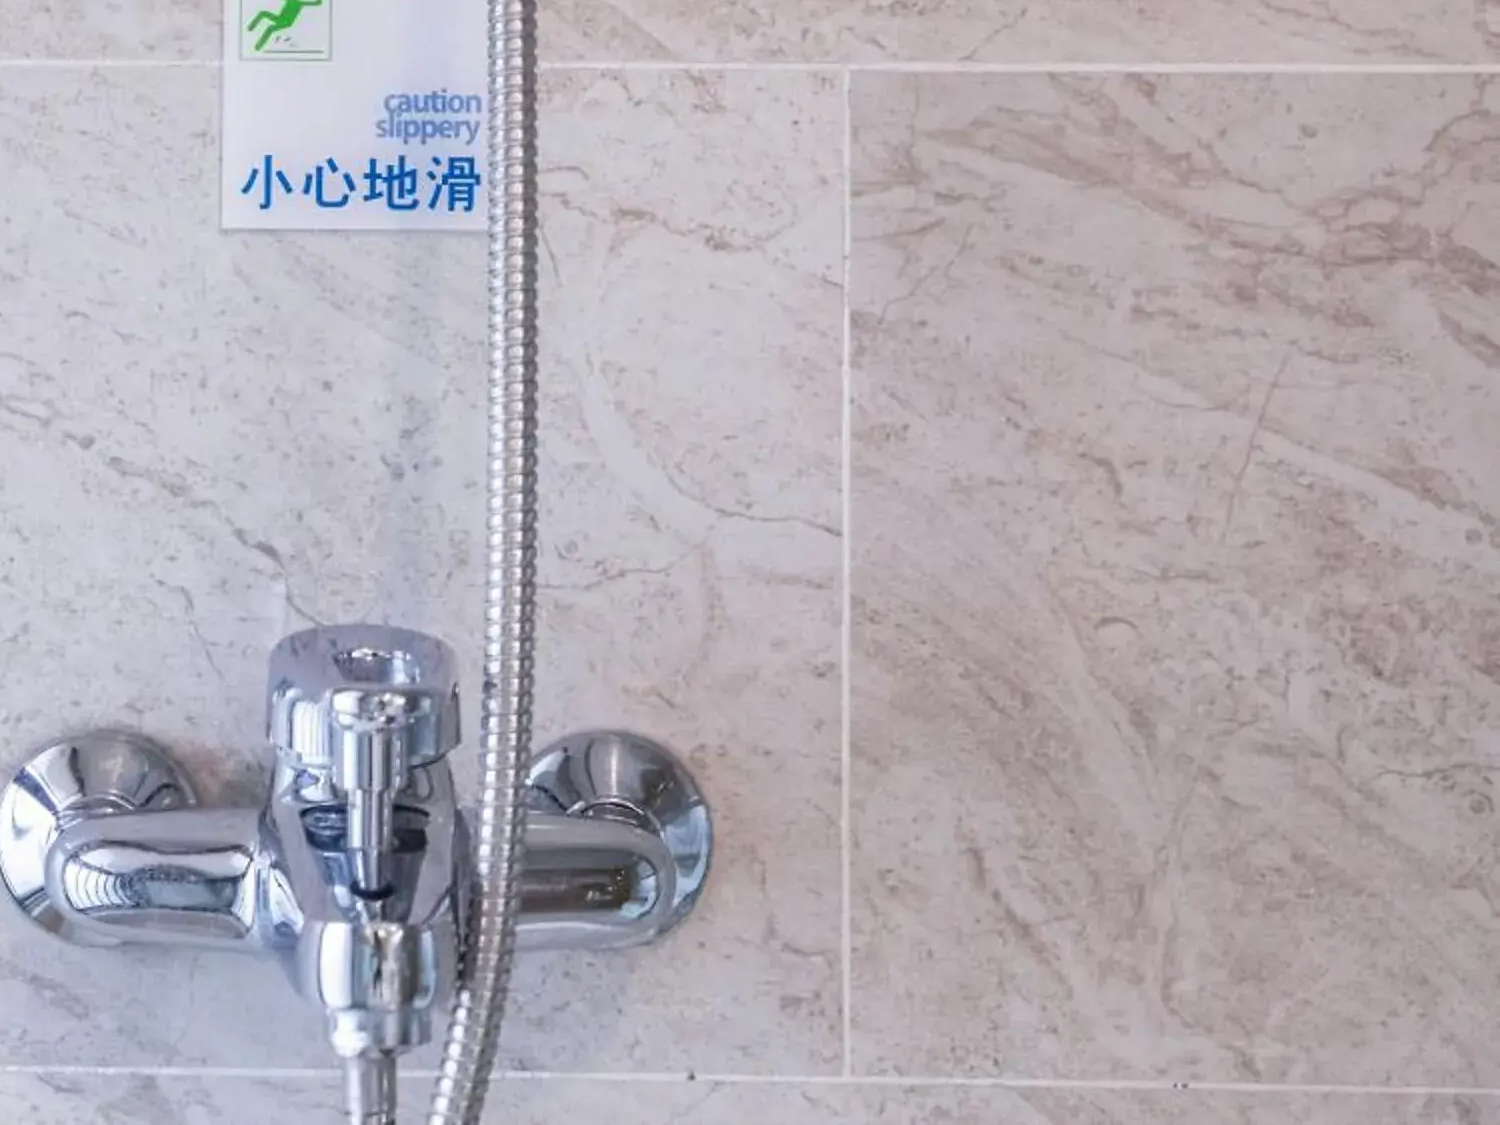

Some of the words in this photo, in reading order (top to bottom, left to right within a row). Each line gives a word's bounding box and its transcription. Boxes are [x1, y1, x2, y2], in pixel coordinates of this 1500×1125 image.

[384, 88, 482, 114] caution
[375, 112, 481, 146] slippery
[241, 154, 481, 212] 小心地滑
